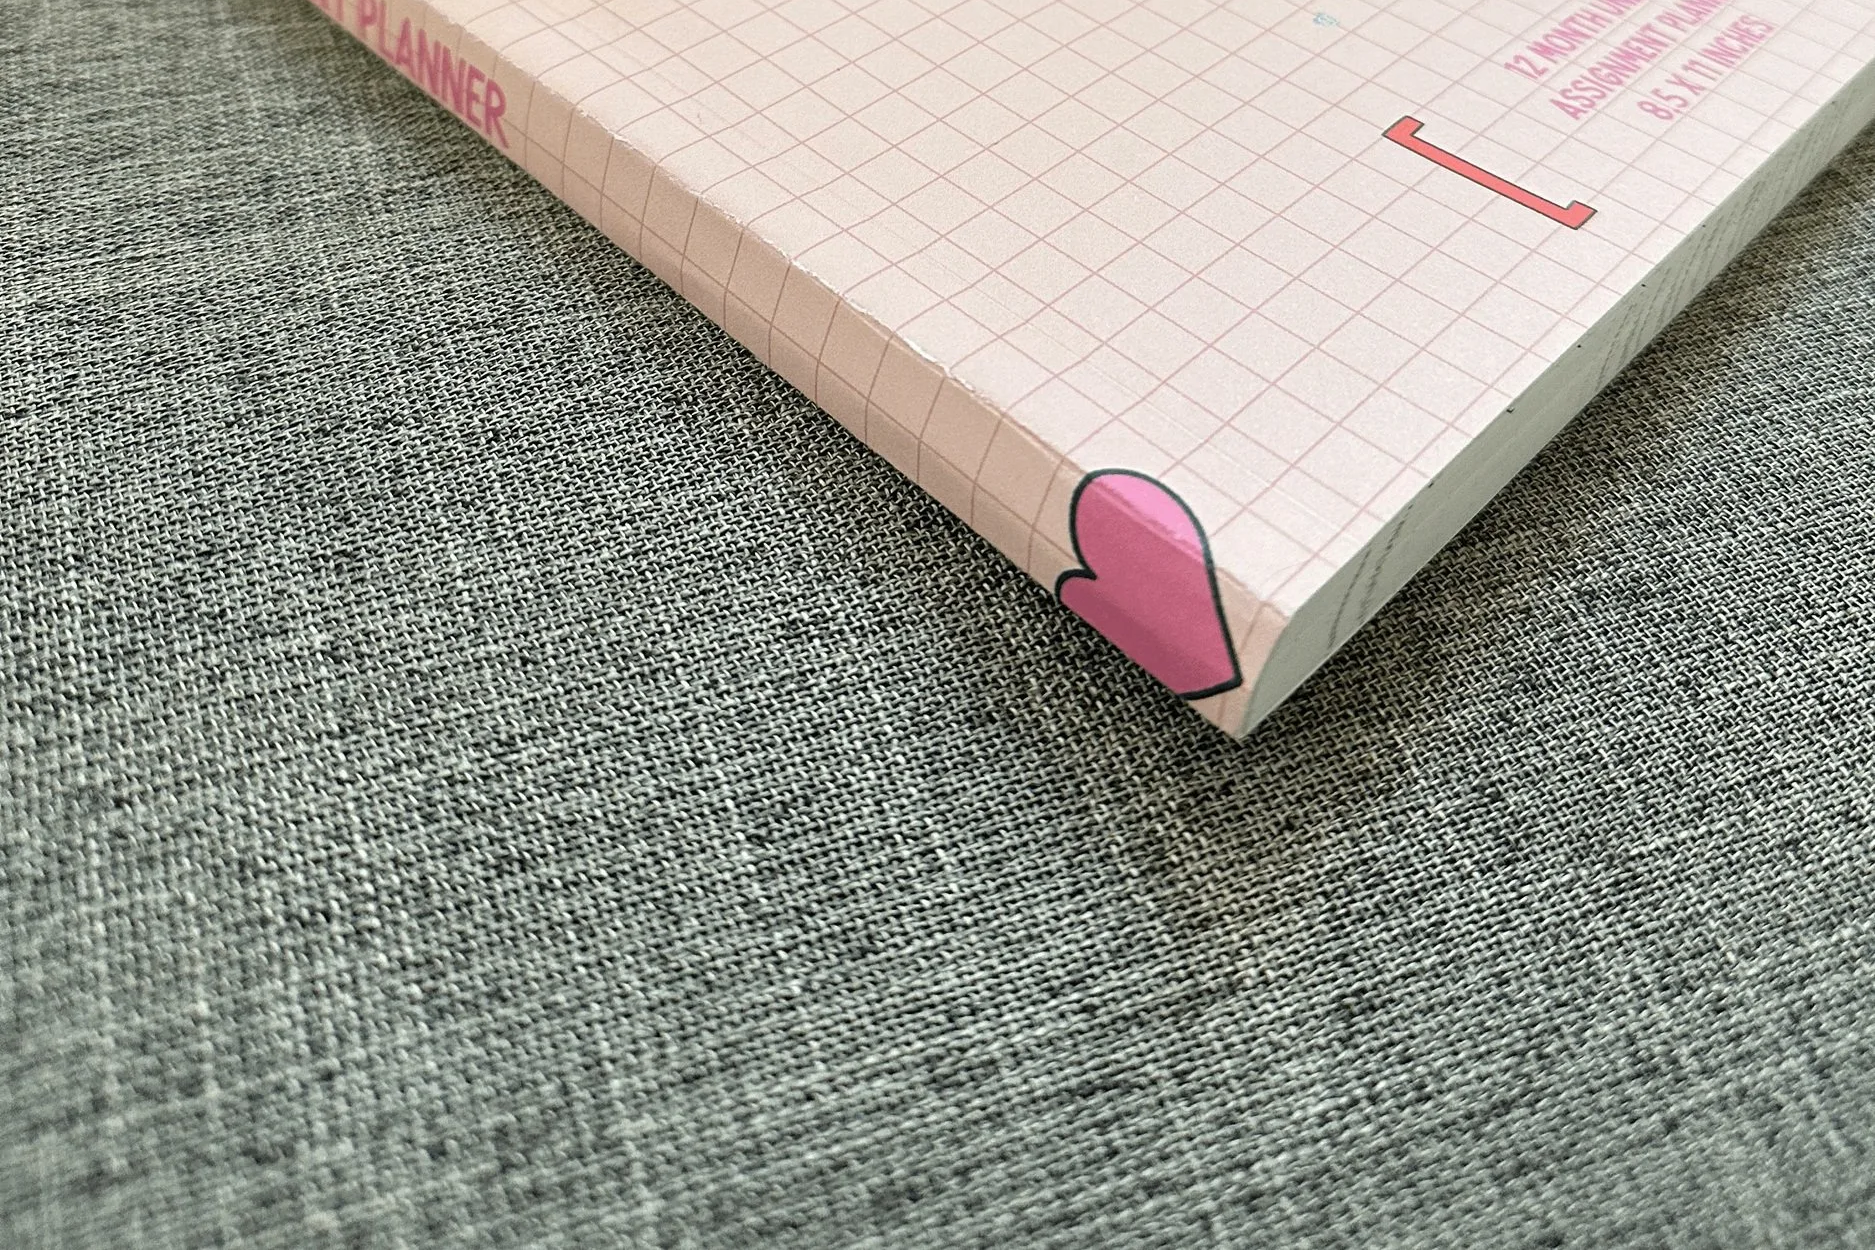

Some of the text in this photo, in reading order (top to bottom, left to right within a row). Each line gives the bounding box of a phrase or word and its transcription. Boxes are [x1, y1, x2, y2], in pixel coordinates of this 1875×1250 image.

[1526, 6, 1612, 65] MONTH
[1698, 14, 1778, 68] INCHES
[1504, 53, 1549, 81] 12
[1551, 23, 1675, 120] ASSIGNMENT
[1682, 58, 1724, 82] 11
